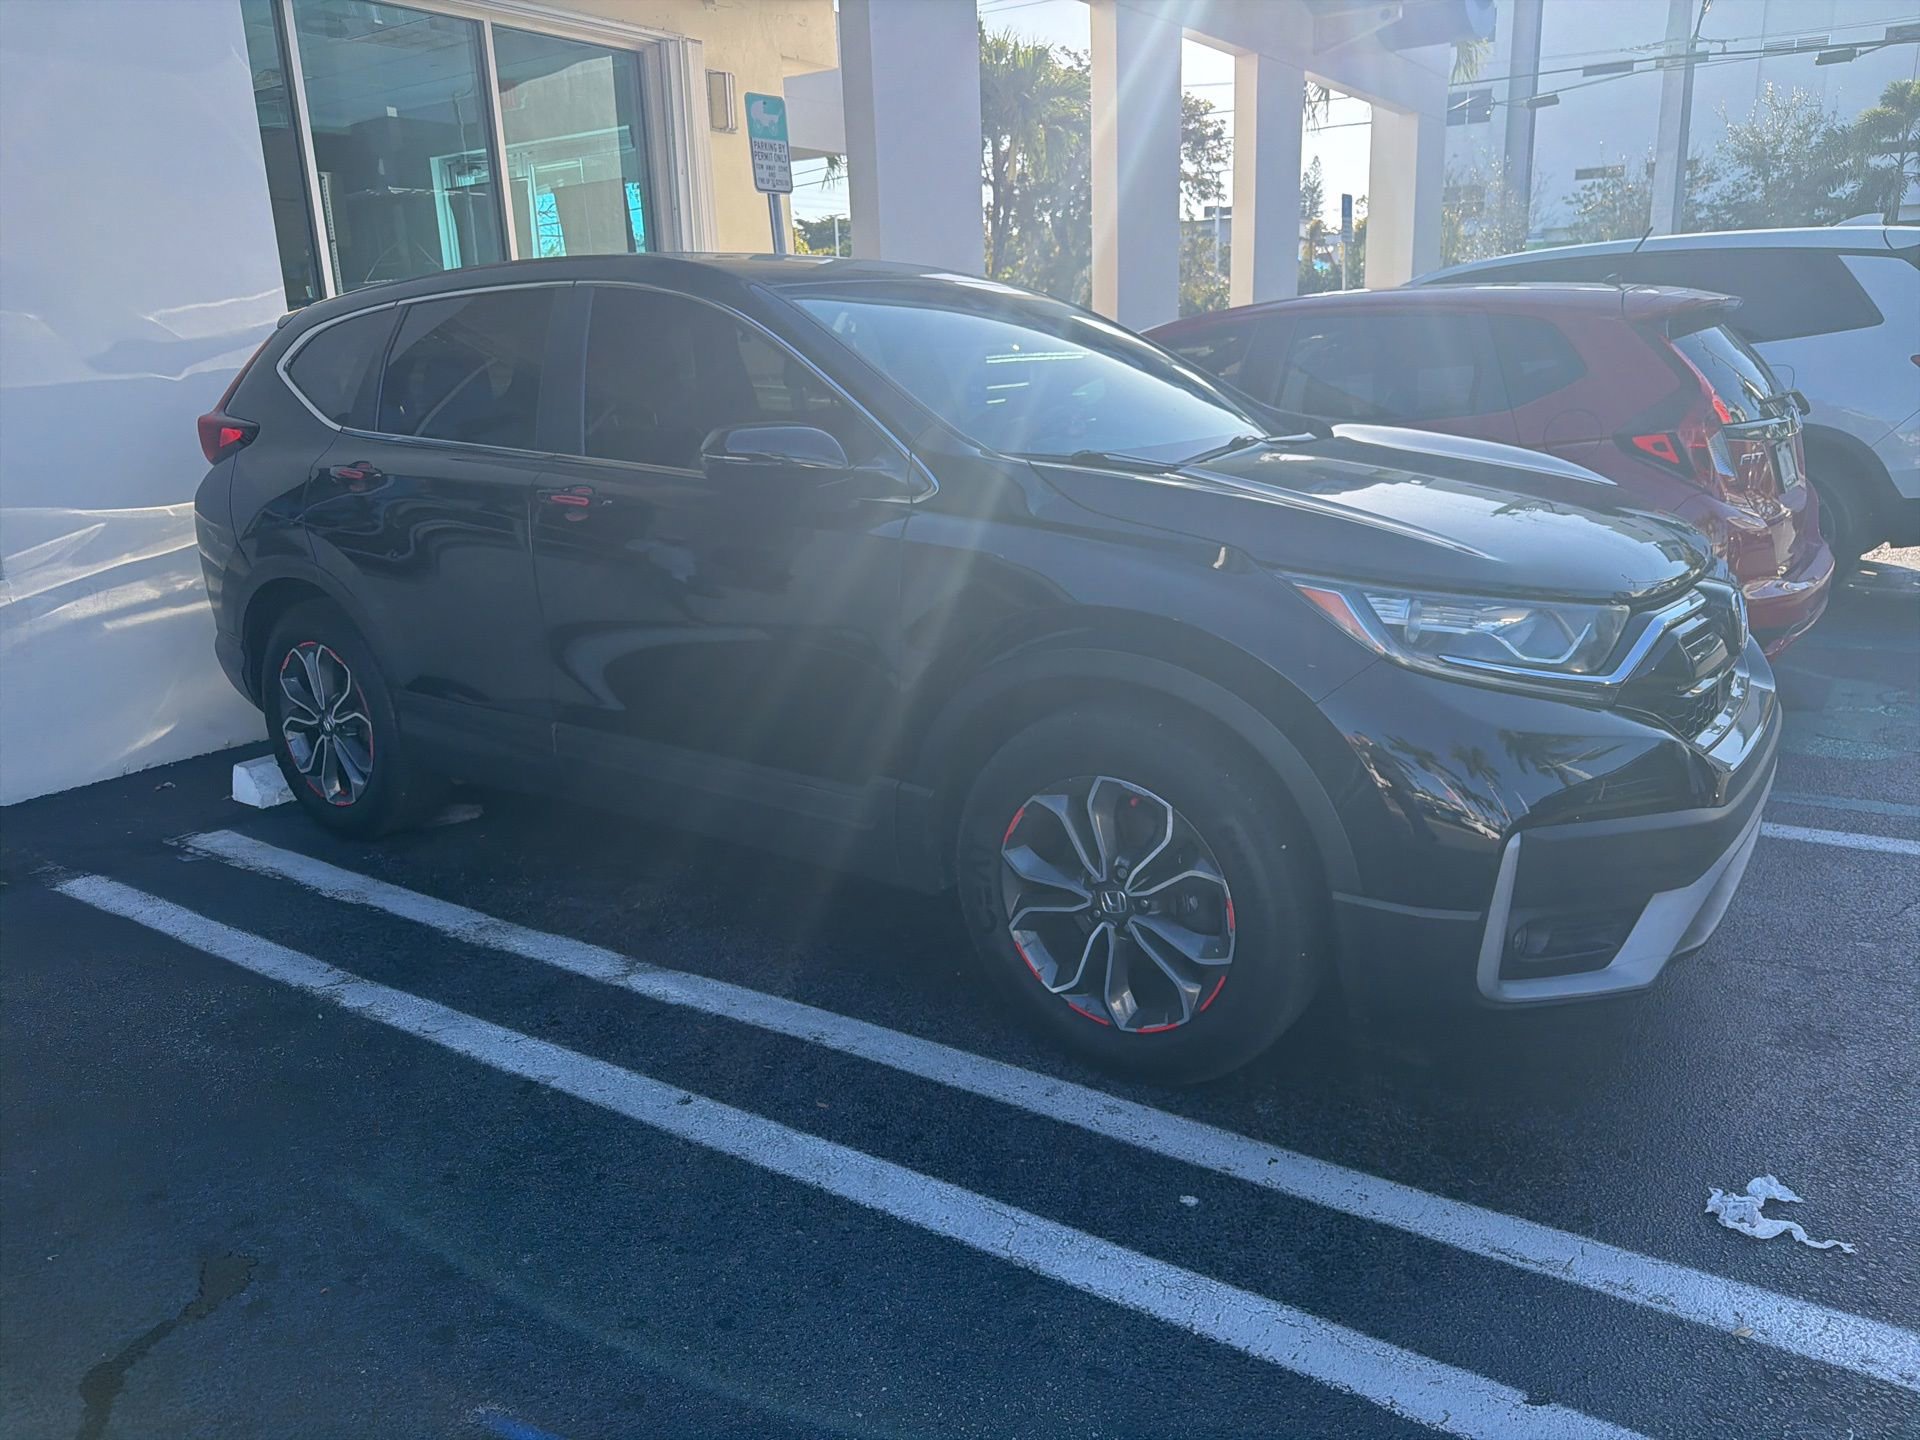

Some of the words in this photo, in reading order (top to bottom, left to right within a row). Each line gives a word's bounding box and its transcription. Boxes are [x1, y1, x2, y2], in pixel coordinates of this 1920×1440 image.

[753, 140, 777, 153] PARKING
[778, 143, 786, 153] BY
[754, 151, 773, 162] PERMIT
[774, 153, 787, 164] ONLY
[1740, 452, 1764, 465] FIT
